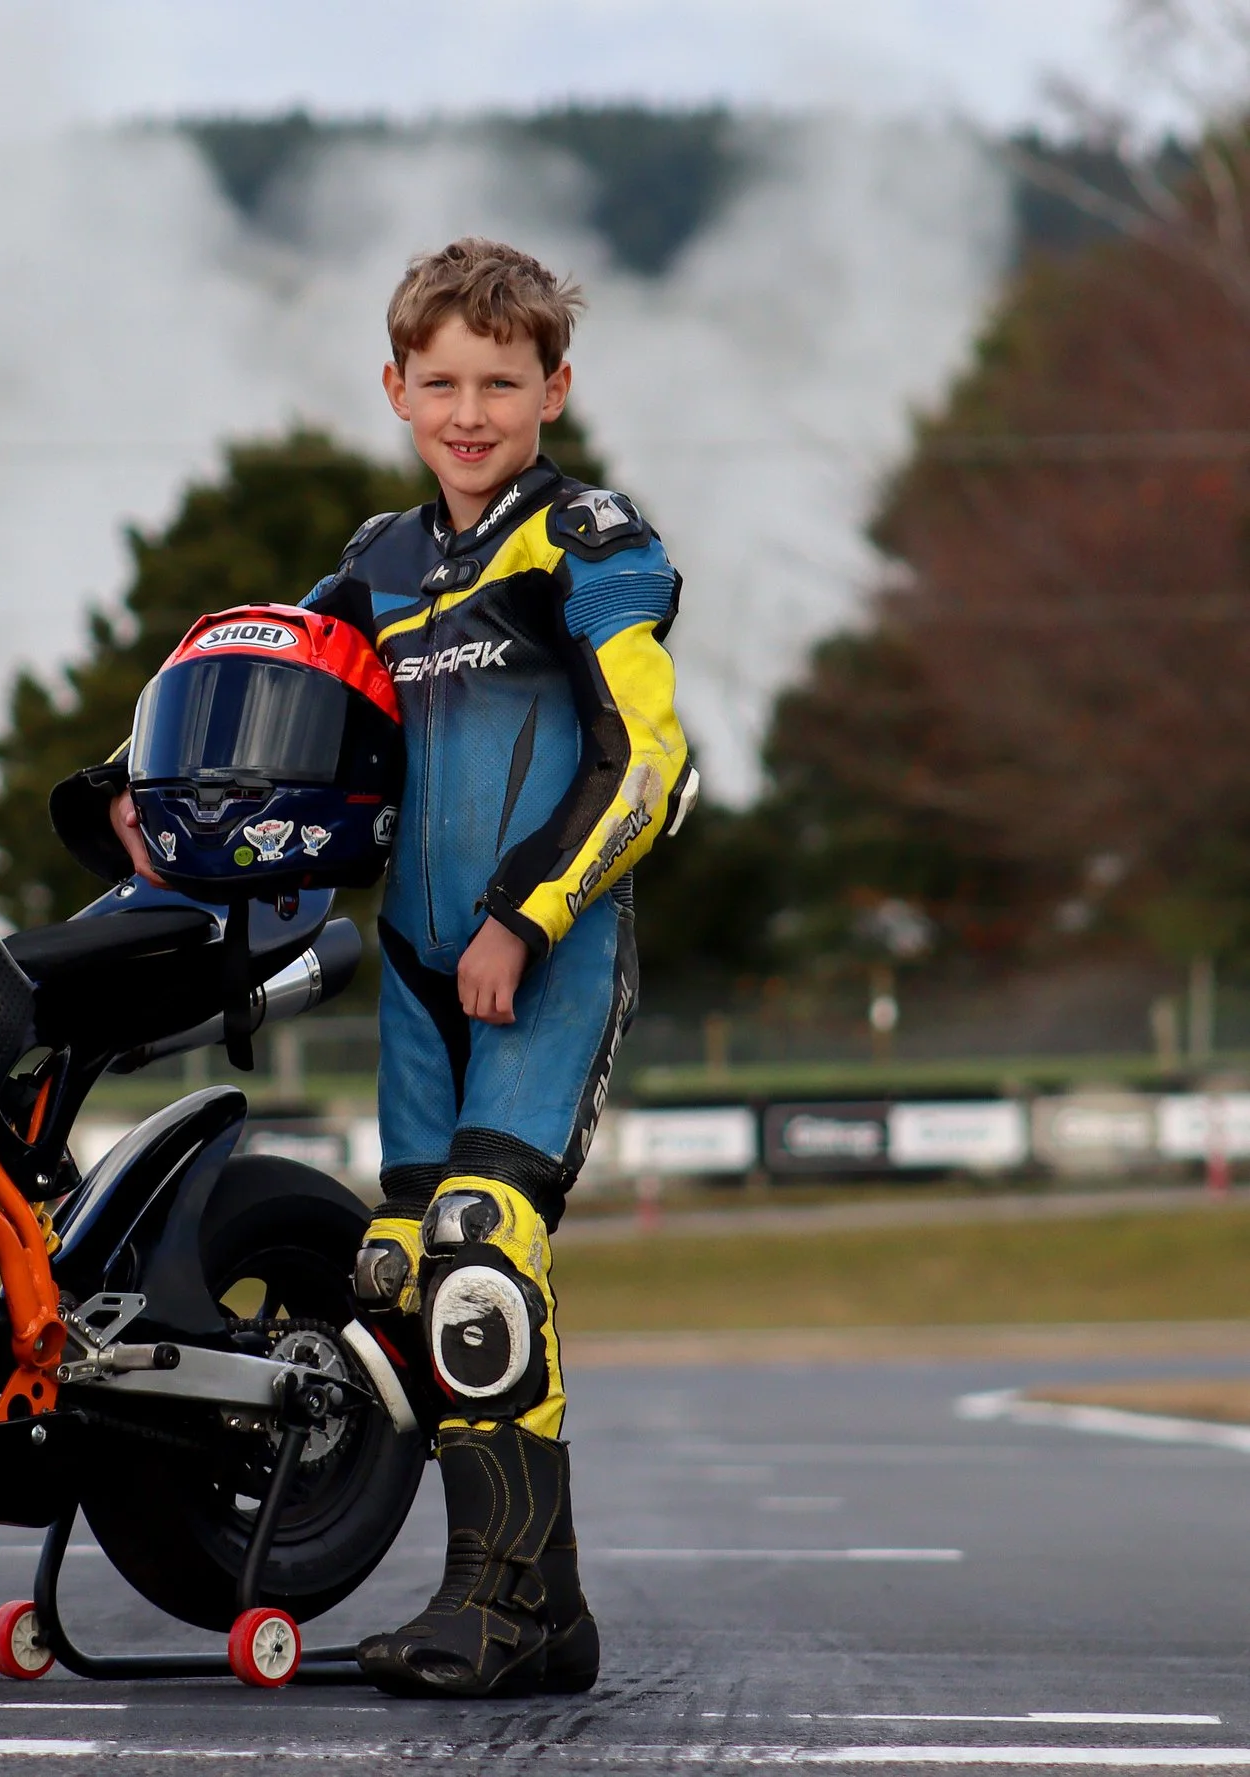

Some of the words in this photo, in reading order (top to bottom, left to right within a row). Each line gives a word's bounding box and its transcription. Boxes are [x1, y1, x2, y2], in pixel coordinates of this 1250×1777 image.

[475, 483, 522, 537] SHARK
[206, 626, 283, 644] SHOEI
[393, 639, 513, 682] SHARK
